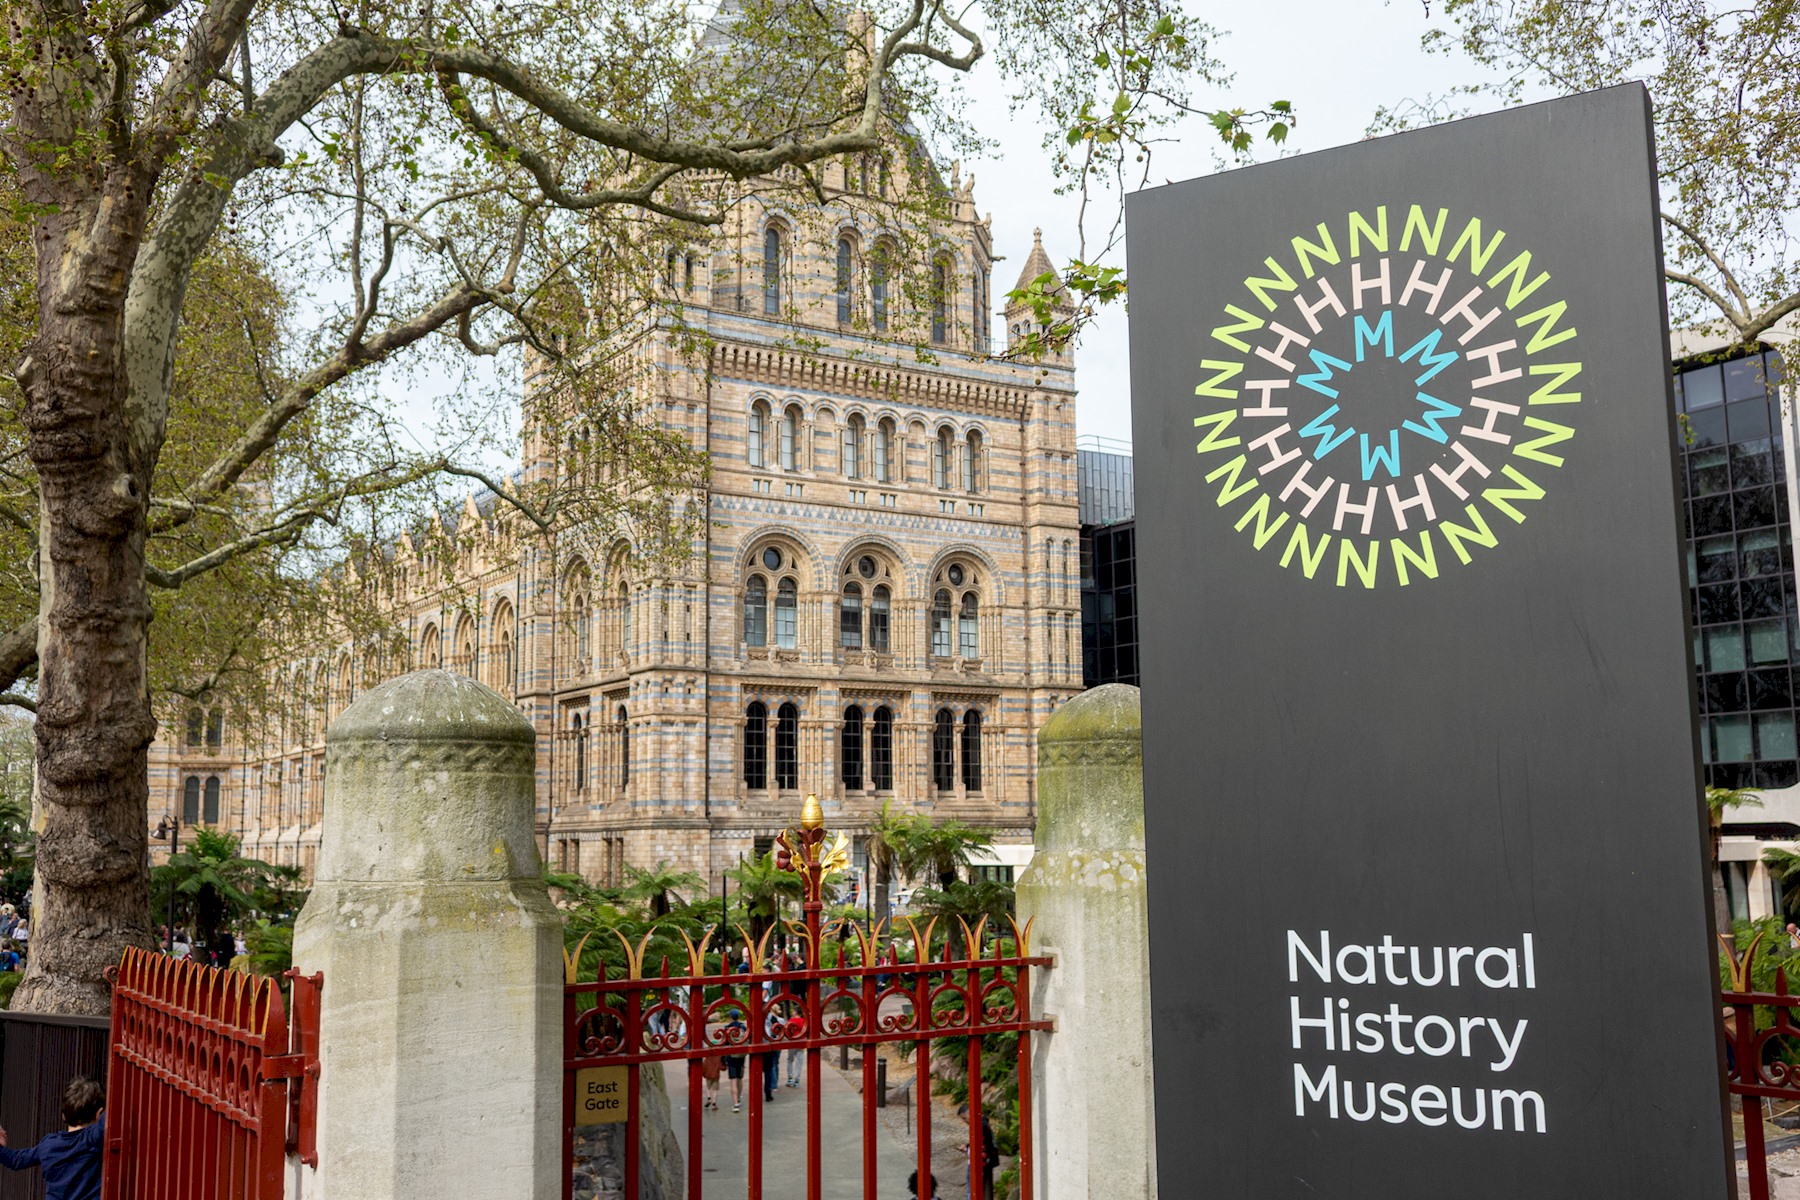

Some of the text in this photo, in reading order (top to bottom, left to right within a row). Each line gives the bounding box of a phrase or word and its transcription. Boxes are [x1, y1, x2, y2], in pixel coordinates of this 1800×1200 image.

[1286, 929, 1536, 989] Natural
[1290, 995, 1529, 1072] History
[585, 1098, 620, 1111] Gate
[587, 1081, 618, 1094] East
[1293, 1062, 1547, 1134] Museum
